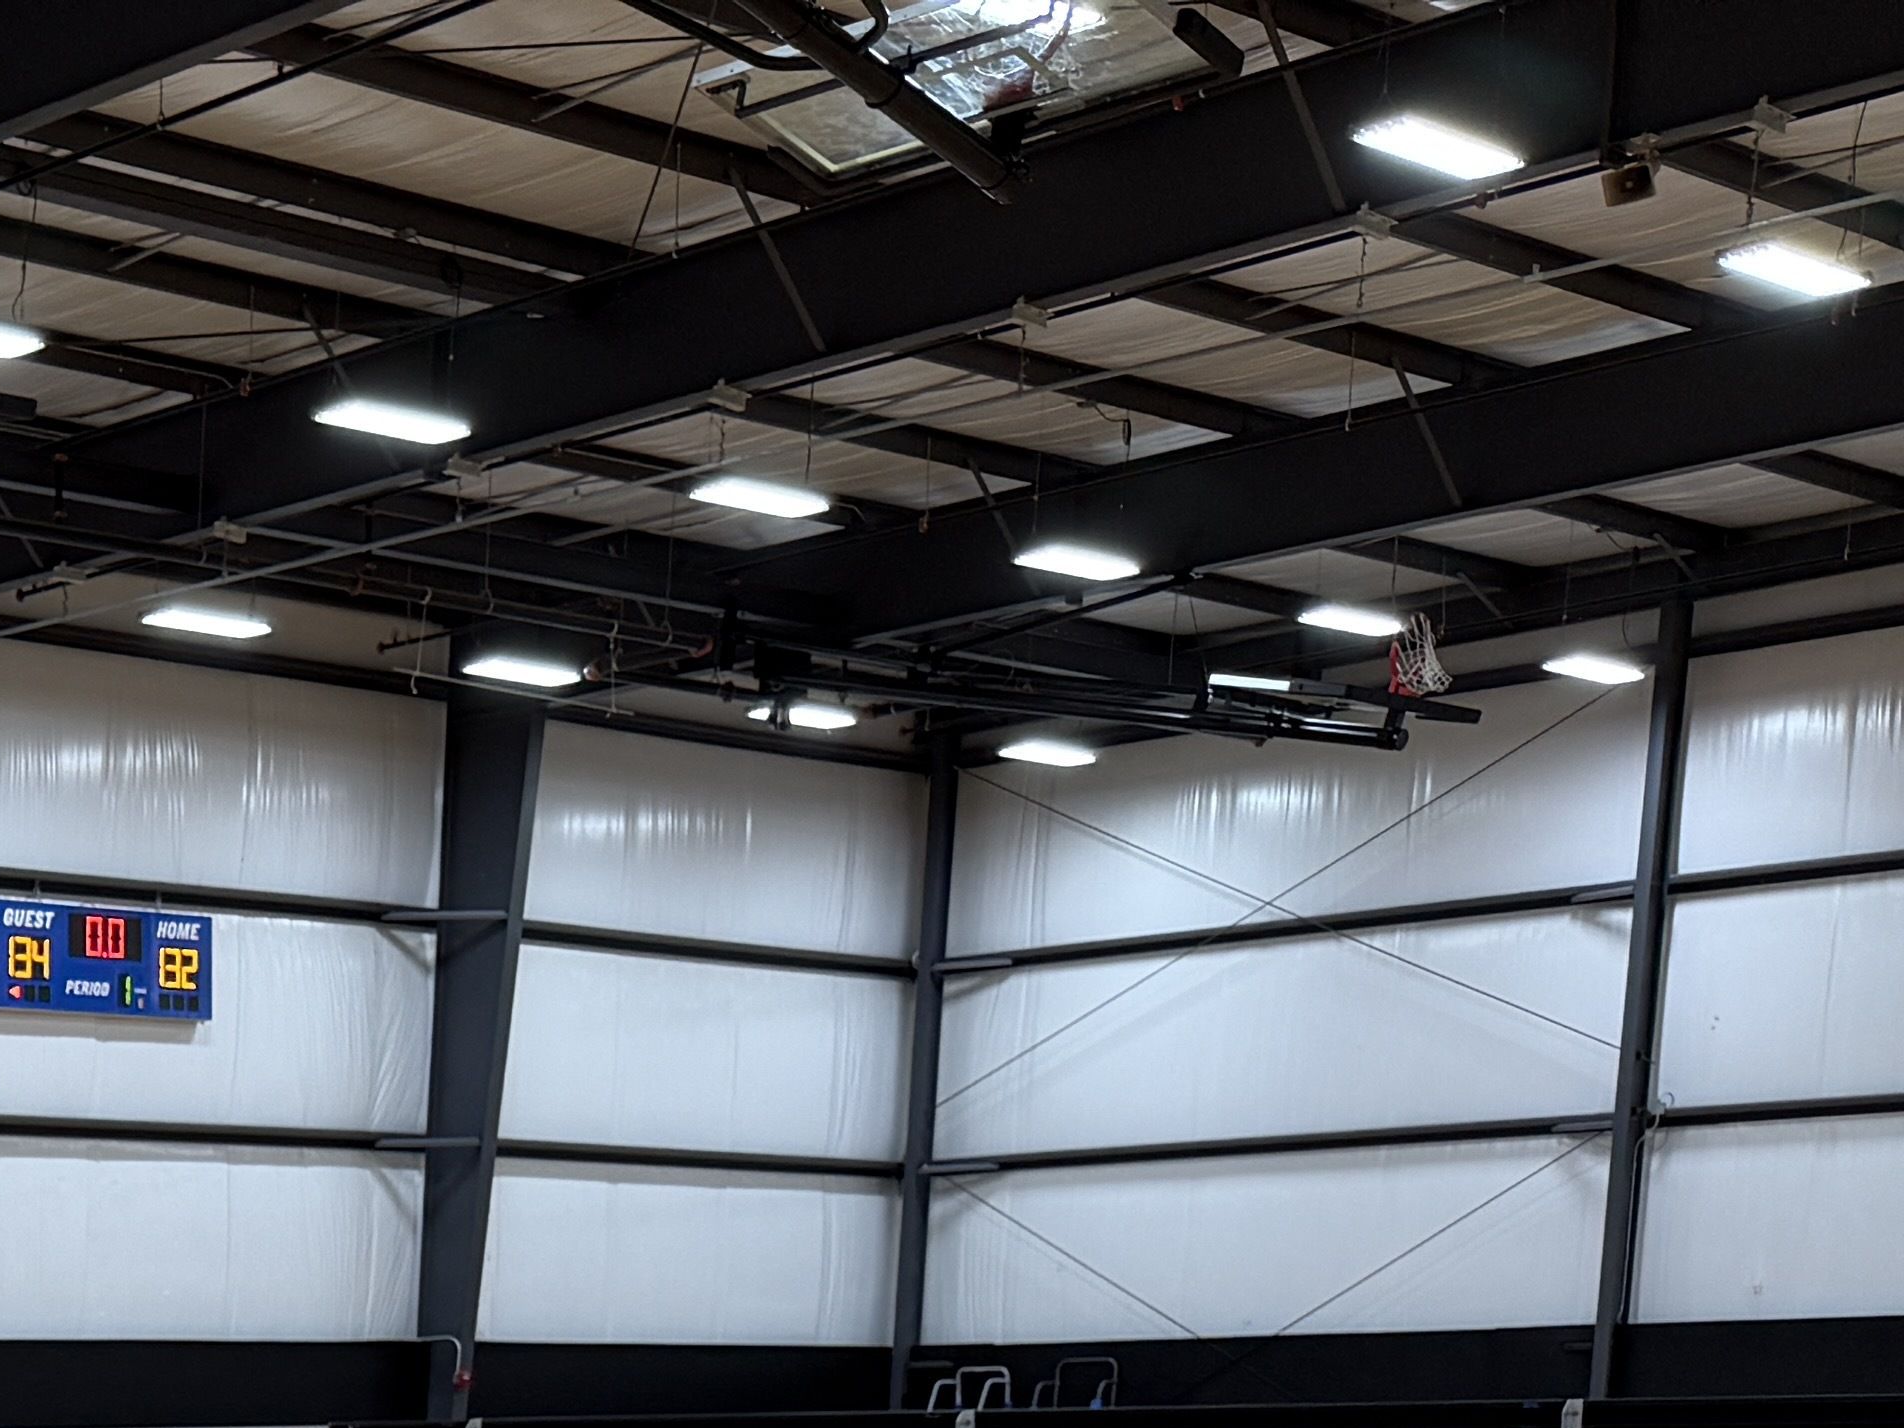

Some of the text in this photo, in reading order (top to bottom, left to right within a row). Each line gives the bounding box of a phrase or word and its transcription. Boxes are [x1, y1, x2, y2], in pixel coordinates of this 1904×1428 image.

[2, 907, 56, 930] GUEST
[157, 920, 202, 941] HOME
[65, 975, 132, 1007] PERIOD 1
